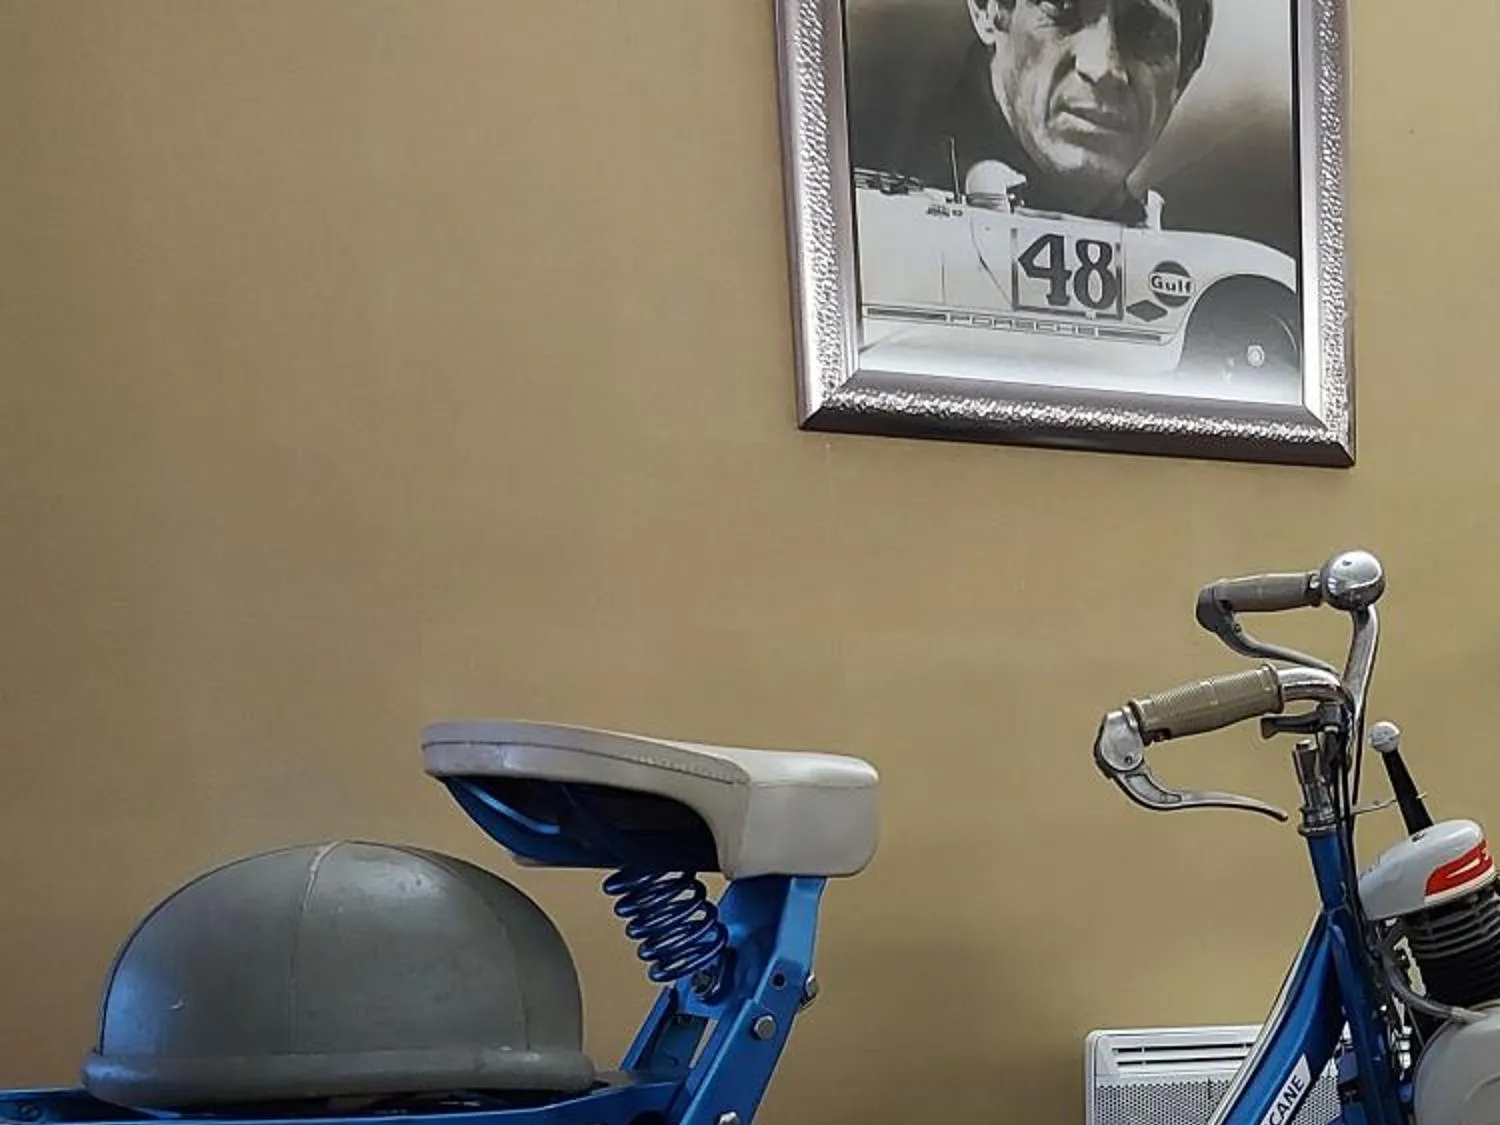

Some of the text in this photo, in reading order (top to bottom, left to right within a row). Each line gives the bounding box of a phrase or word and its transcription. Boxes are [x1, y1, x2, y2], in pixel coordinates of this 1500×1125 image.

[1018, 233, 1118, 310] 48
[1151, 275, 1192, 293] Gulf
[949, 314, 1097, 336] PORSCHE
